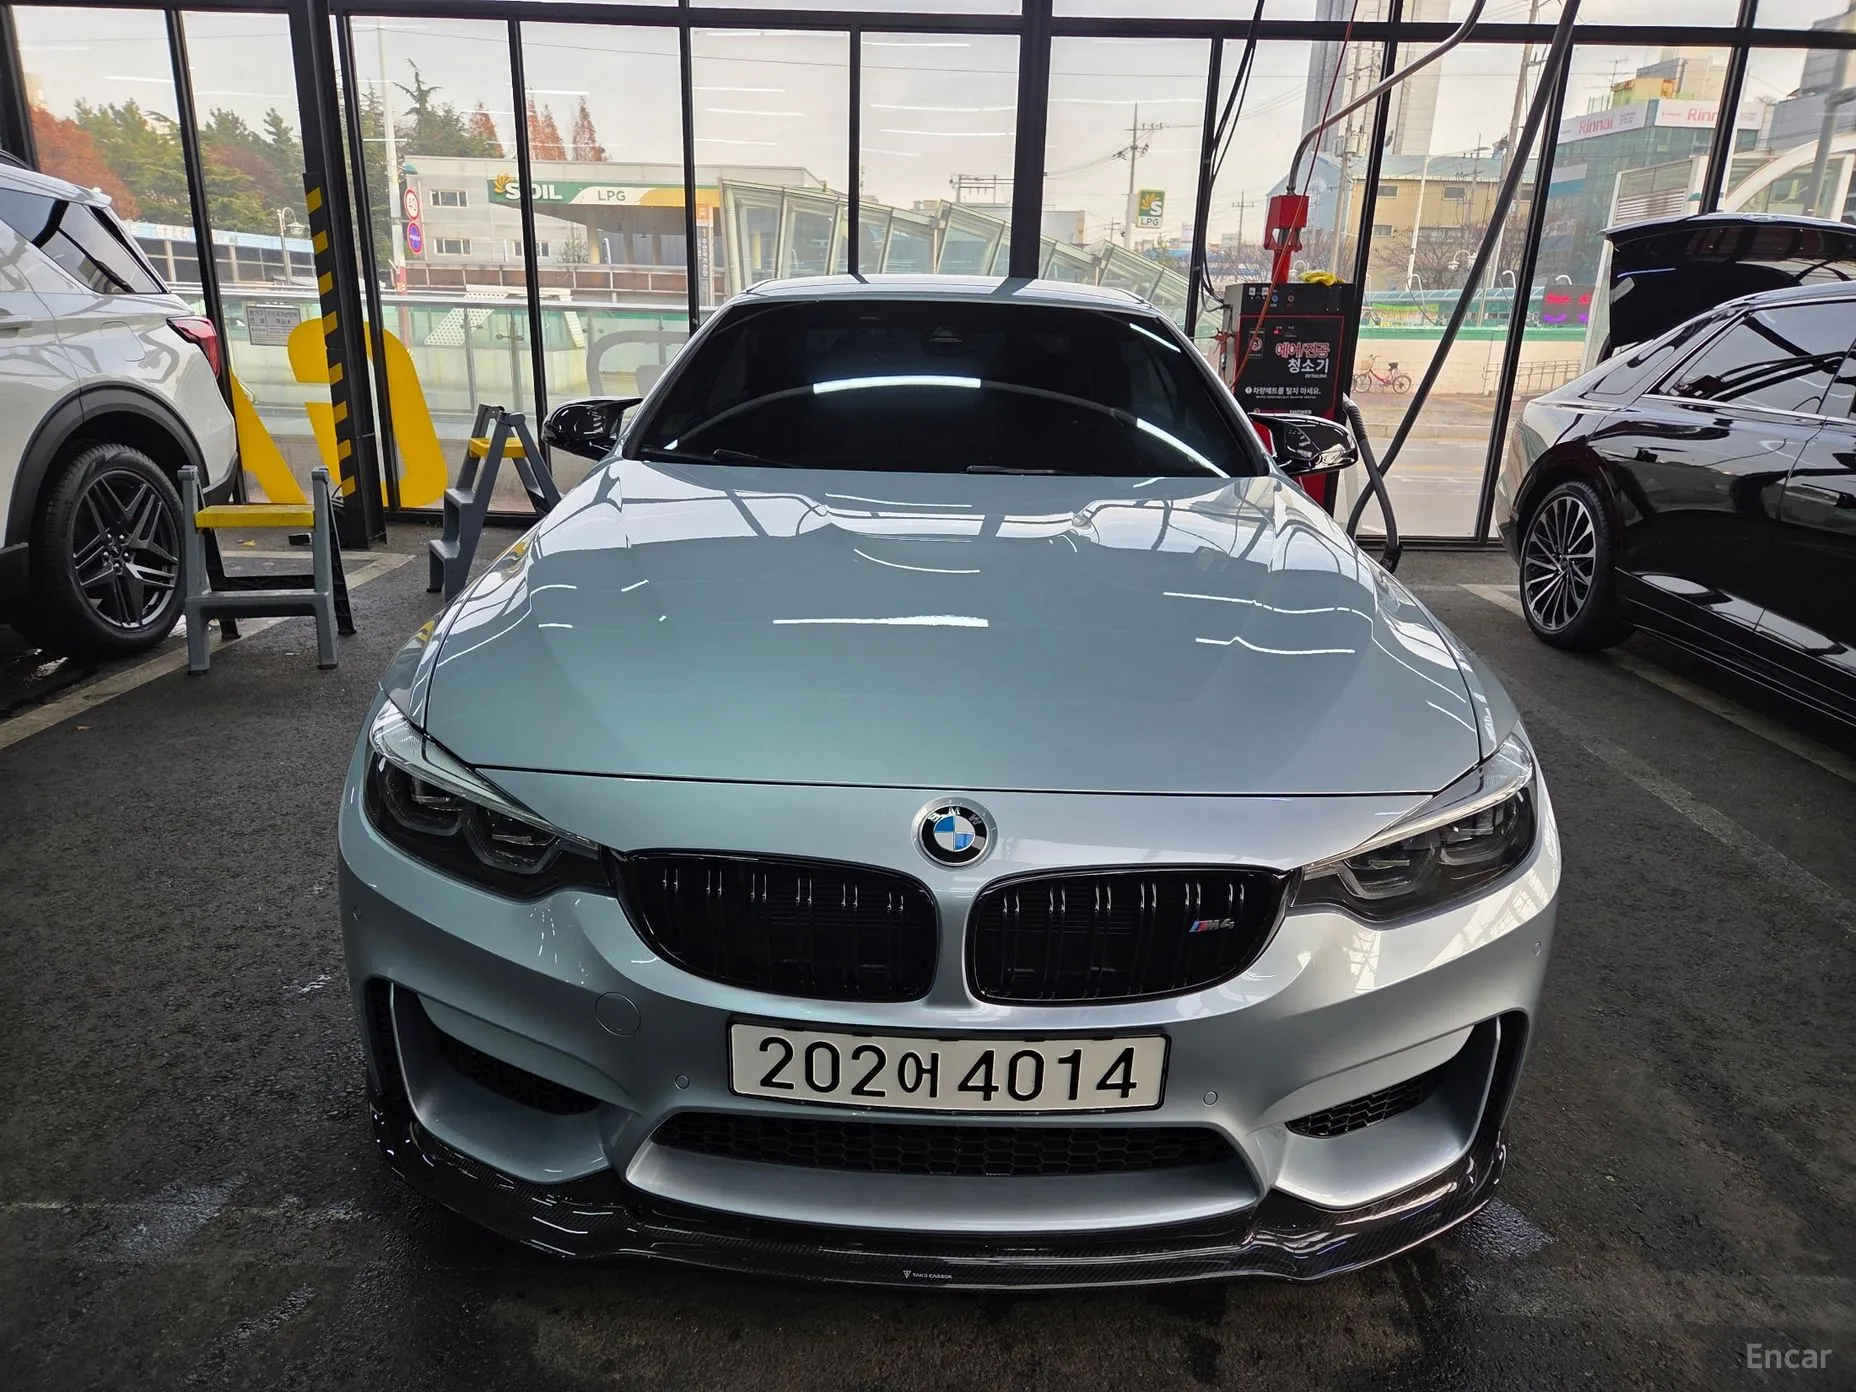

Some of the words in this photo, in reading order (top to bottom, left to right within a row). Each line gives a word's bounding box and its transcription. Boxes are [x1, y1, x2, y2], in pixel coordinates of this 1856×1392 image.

[1578, 115, 1614, 136] Rinnai
[505, 182, 562, 200] SOIL
[598, 190, 626, 201] LPG
[1150, 201, 1162, 216] S
[1141, 218, 1159, 226] LPG
[1288, 358, 1329, 373] 청소기
[928, 806, 982, 826] BMW
[759, 1036, 940, 1098] 202어
[957, 1046, 1138, 1102] 4014
